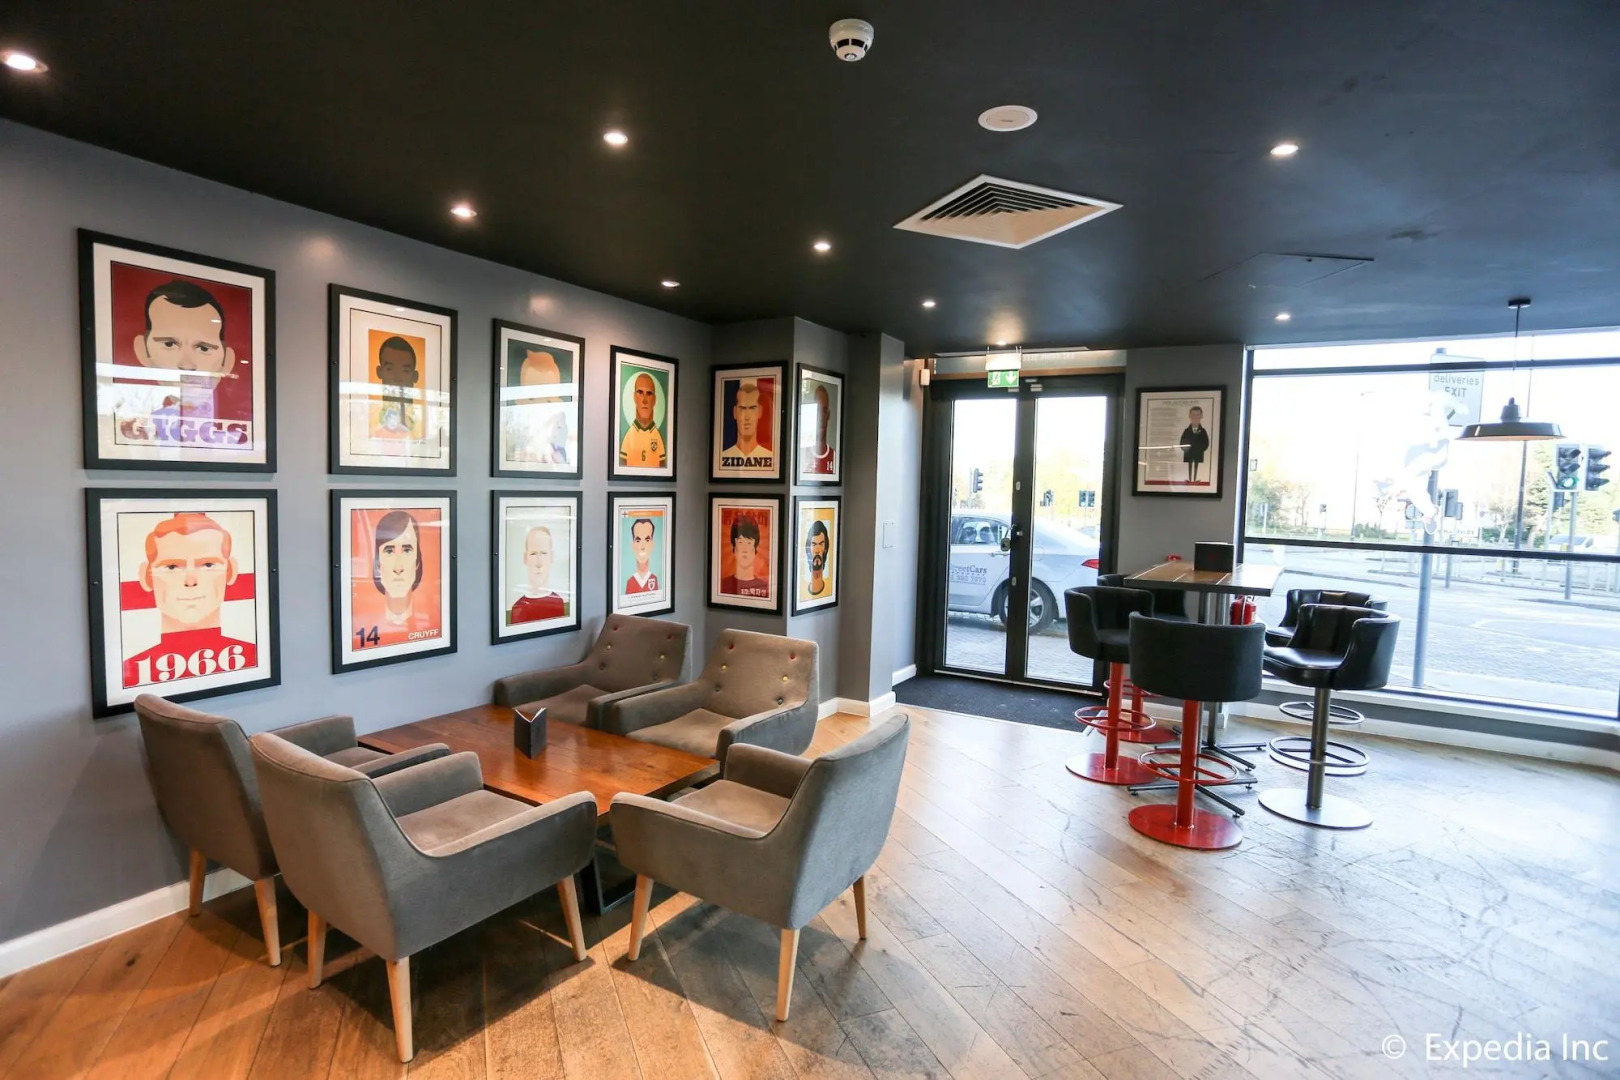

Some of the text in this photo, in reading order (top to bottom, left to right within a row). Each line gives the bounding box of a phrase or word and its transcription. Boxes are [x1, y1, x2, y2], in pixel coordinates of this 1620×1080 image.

[1433, 373, 1479, 386] deliveries
[1444, 386, 1467, 398] EXIT
[120, 418, 248, 446] GIGGS
[641, 450, 646, 461] 6
[722, 456, 773, 468] ZIDANE
[355, 626, 381, 648] 14
[408, 628, 440, 641] CRUYFF
[134, 644, 247, 686] 1966
